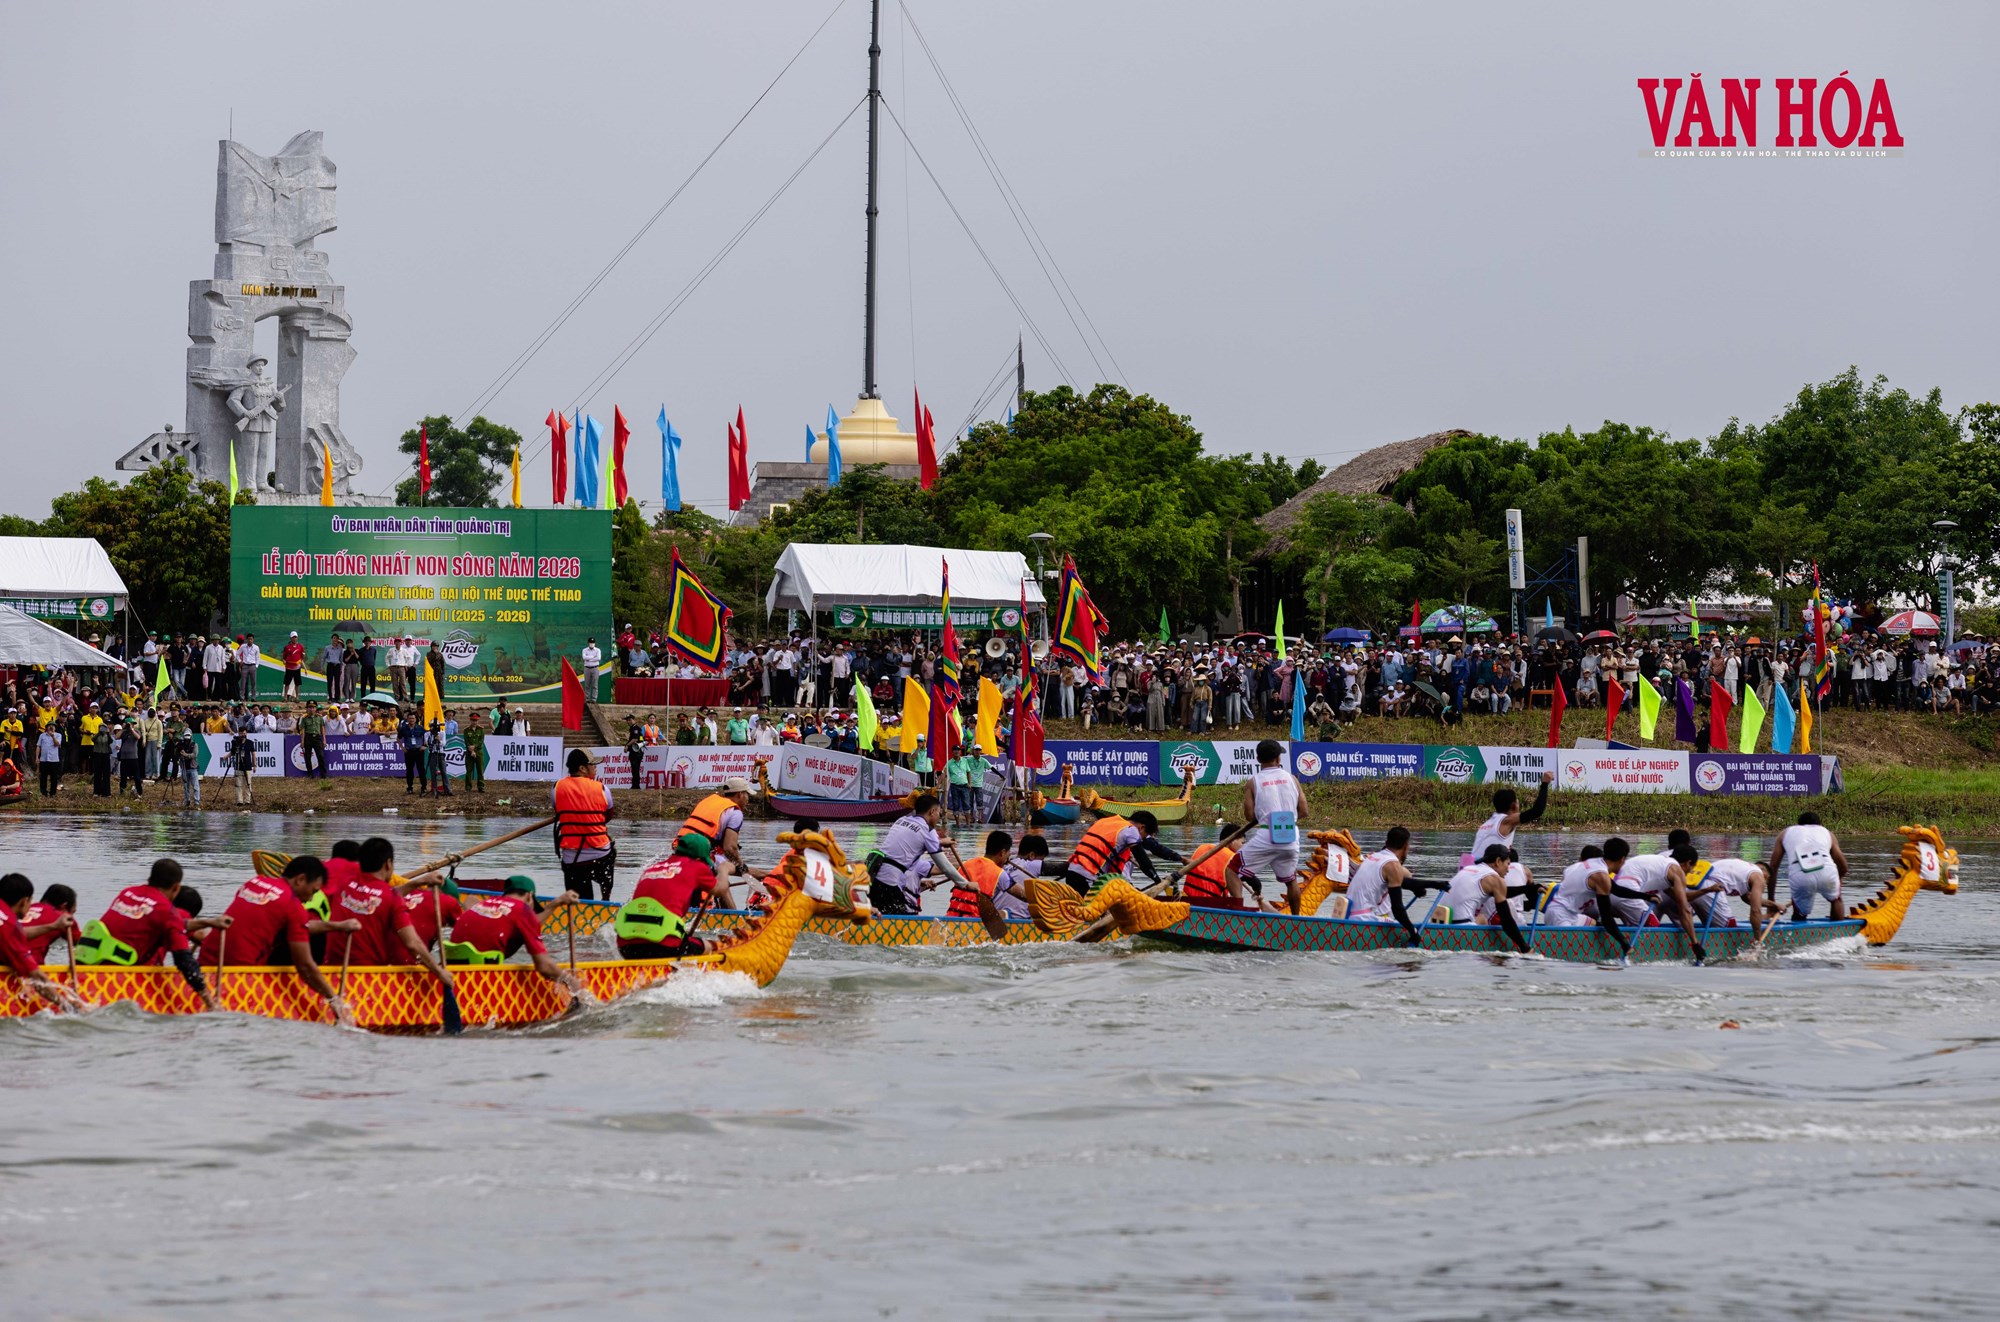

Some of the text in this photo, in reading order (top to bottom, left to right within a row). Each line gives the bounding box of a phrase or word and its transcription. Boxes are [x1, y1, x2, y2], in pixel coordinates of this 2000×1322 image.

[242, 284, 262, 296] NAM
[332, 515, 511, 537] ỦY BAN NHÂN DÂN TỈNH QUẢNG TRỊ
[262, 547, 581, 579] LỄ HỘI THỐNG NHẤT NON SÔNG NĂM 2026
[261, 582, 282, 599] GIẢI
[286, 586, 308, 600] ĐUA
[440, 588, 459, 603] ĐẠI
[462, 585, 480, 603] HỘI
[506, 589, 528, 604] DỤC
[554, 589, 582, 602] THAO
[309, 604, 333, 621] TỈNH
[336, 605, 373, 622] QUẢNG
[376, 608, 393, 623] TRỊ
[420, 608, 442, 621] THỨ
[444, 609, 448, 621] I
[451, 609, 486, 622] (2025
[496, 610, 531, 623] 2026)
[441, 638, 478, 656] huda
[460, 674, 480, 683] tháng
[338, 742, 349, 751] HỘI
[366, 743, 380, 752] DỤC
[504, 742, 548, 758] ĐẬM TÌNH
[1234, 747, 1255, 762] ĐẬM
[385, 753, 396, 762] TRỊ
[698, 755, 709, 763] ĐẠI
[710, 753, 720, 763] HỘI
[733, 755, 745, 764] DỤC
[1067, 748, 1148, 764] KHỎE ĐỂ XÂY DỰNG
[1169, 753, 1209, 769] huda
[1326, 752, 1348, 762] ĐOÀN
[1349, 751, 1363, 763] KẾT
[1370, 754, 1396, 764] TRUNG
[1398, 755, 1417, 766] THỰC
[1500, 753, 1543, 768] ĐẬM TÌNH
[364, 763, 383, 771] (2025
[524, 760, 554, 772] TRUNG
[712, 762, 725, 772] TỈNH
[726, 762, 746, 773] QUẢNG
[1080, 762, 1148, 777] BẢO VỆ TỔ QUỐC
[1330, 766, 1345, 776] CAO
[1434, 758, 1474, 774] huda
[1596, 757, 1679, 772] KHỎE ĐỂ LẬP NGHIỆP
[1726, 762, 1738, 772] ĐẠI
[1740, 762, 1750, 772] HỘI
[1766, 763, 1779, 772] DỤC
[1520, 771, 1543, 783] TRUN
[1612, 774, 1623, 783] VÀ
[1641, 773, 1663, 783] NƯỚC
[1744, 772, 1796, 782] TỈNH QUẢNG TRỊ
[1764, 784, 1783, 792] (2025
[1789, 784, 1808, 792] 2026)
[1335, 854, 1343, 872] 1
[1926, 850, 1935, 870] 3
[814, 861, 826, 887] 4
